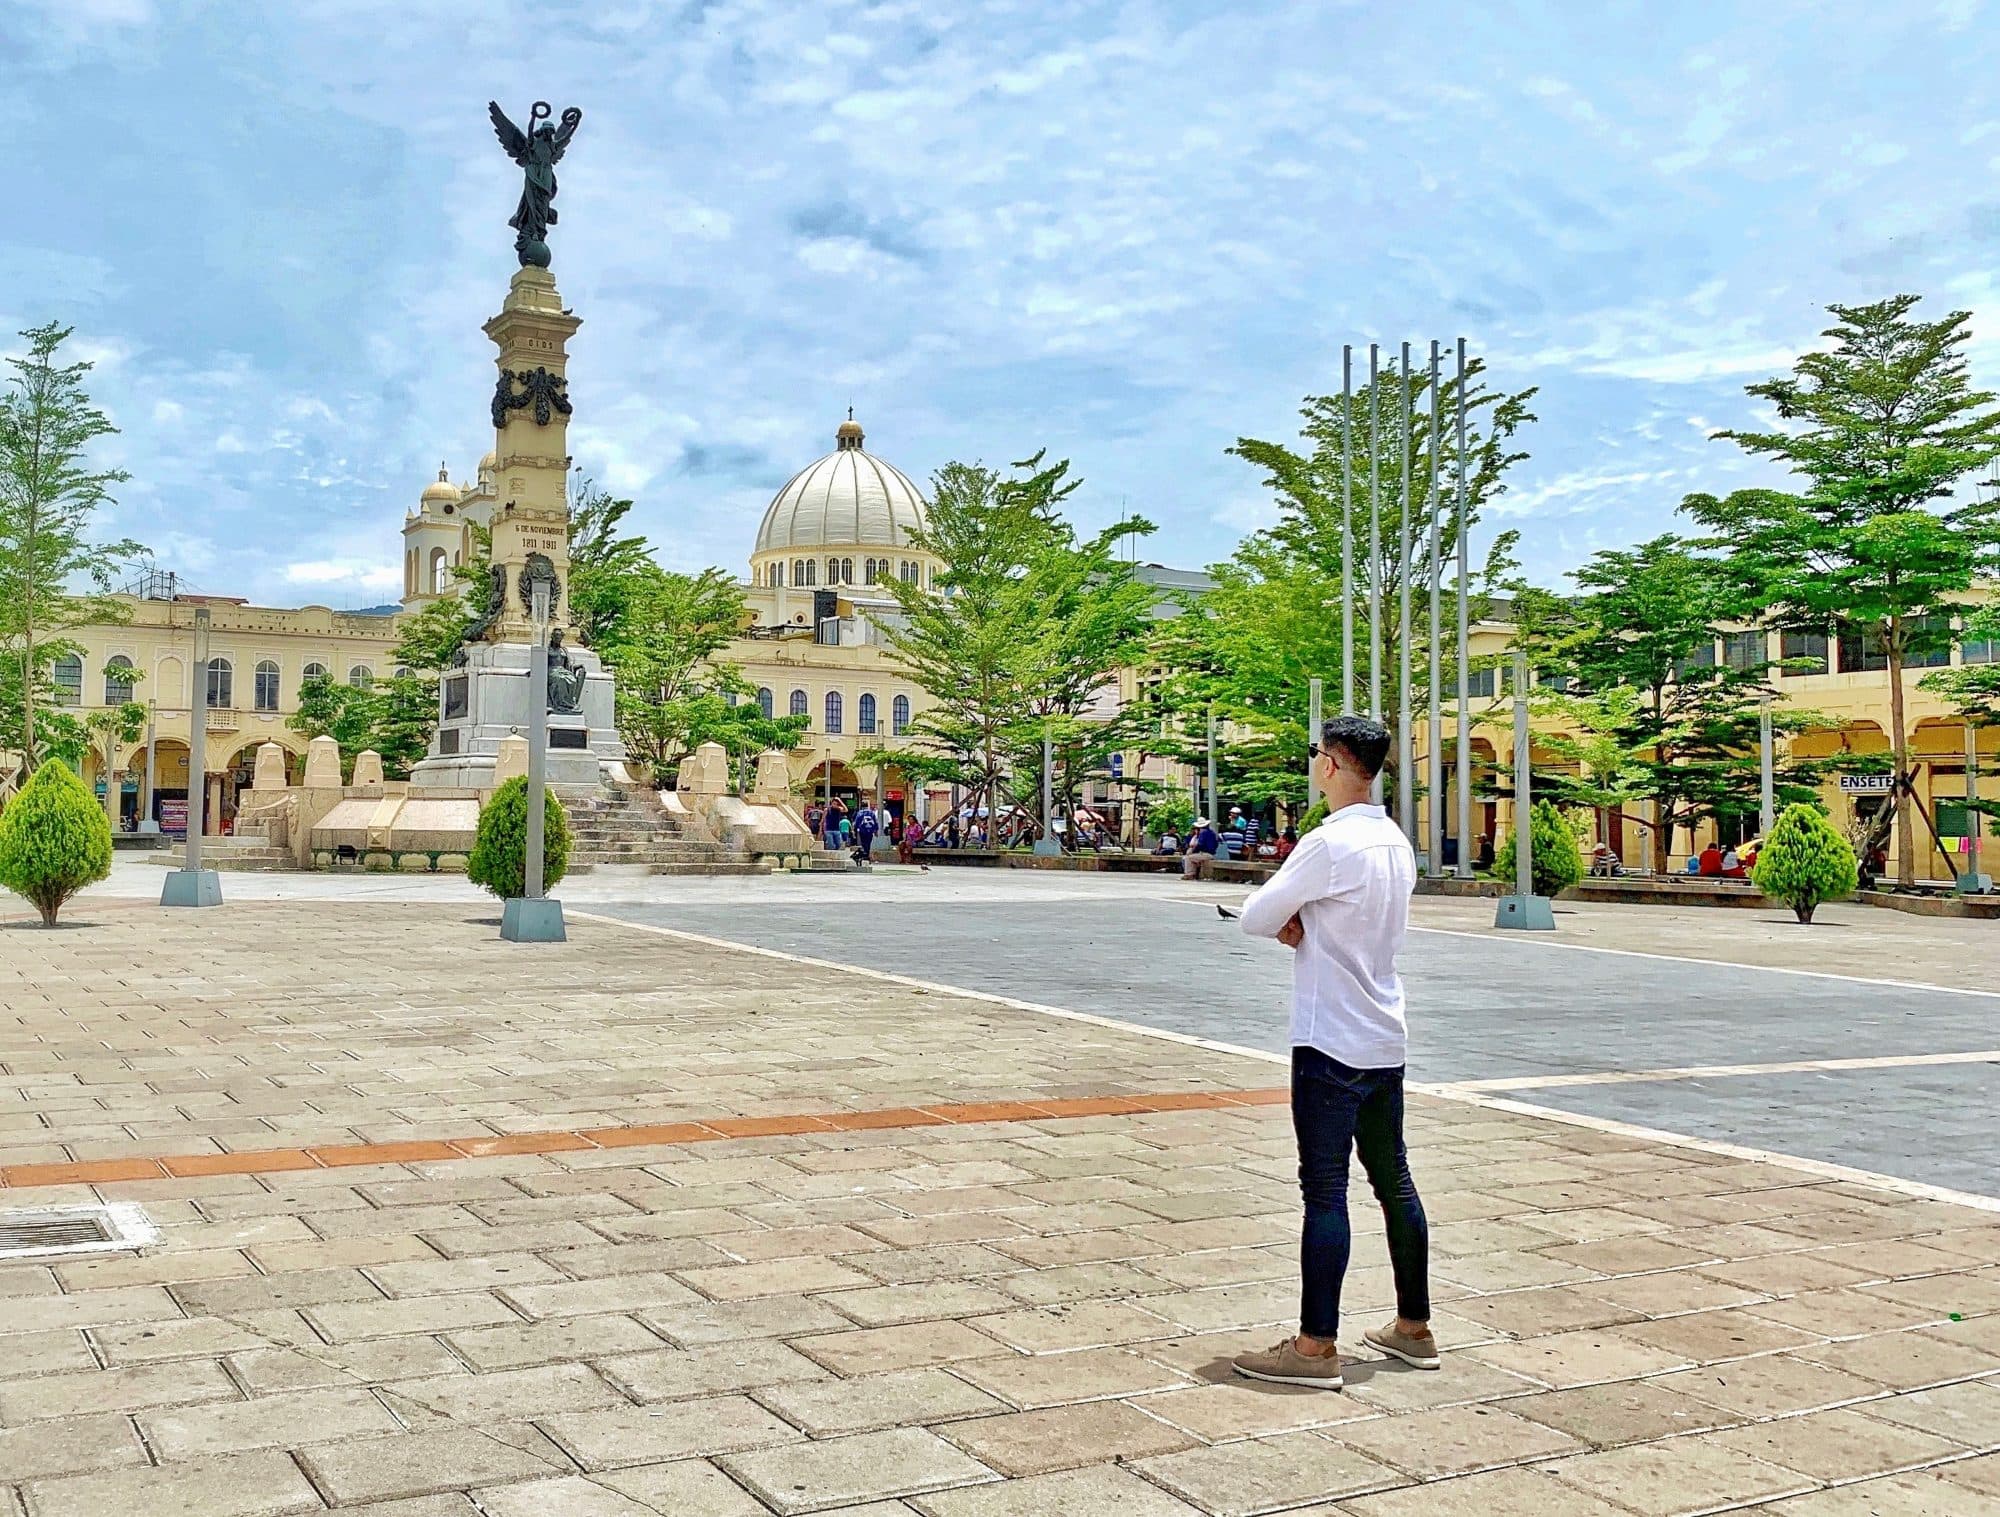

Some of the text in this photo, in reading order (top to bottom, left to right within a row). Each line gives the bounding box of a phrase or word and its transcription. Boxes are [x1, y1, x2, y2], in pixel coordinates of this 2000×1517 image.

[530, 526, 565, 536] NOVIEMBRE
[522, 538, 557, 550] 1811 1911
